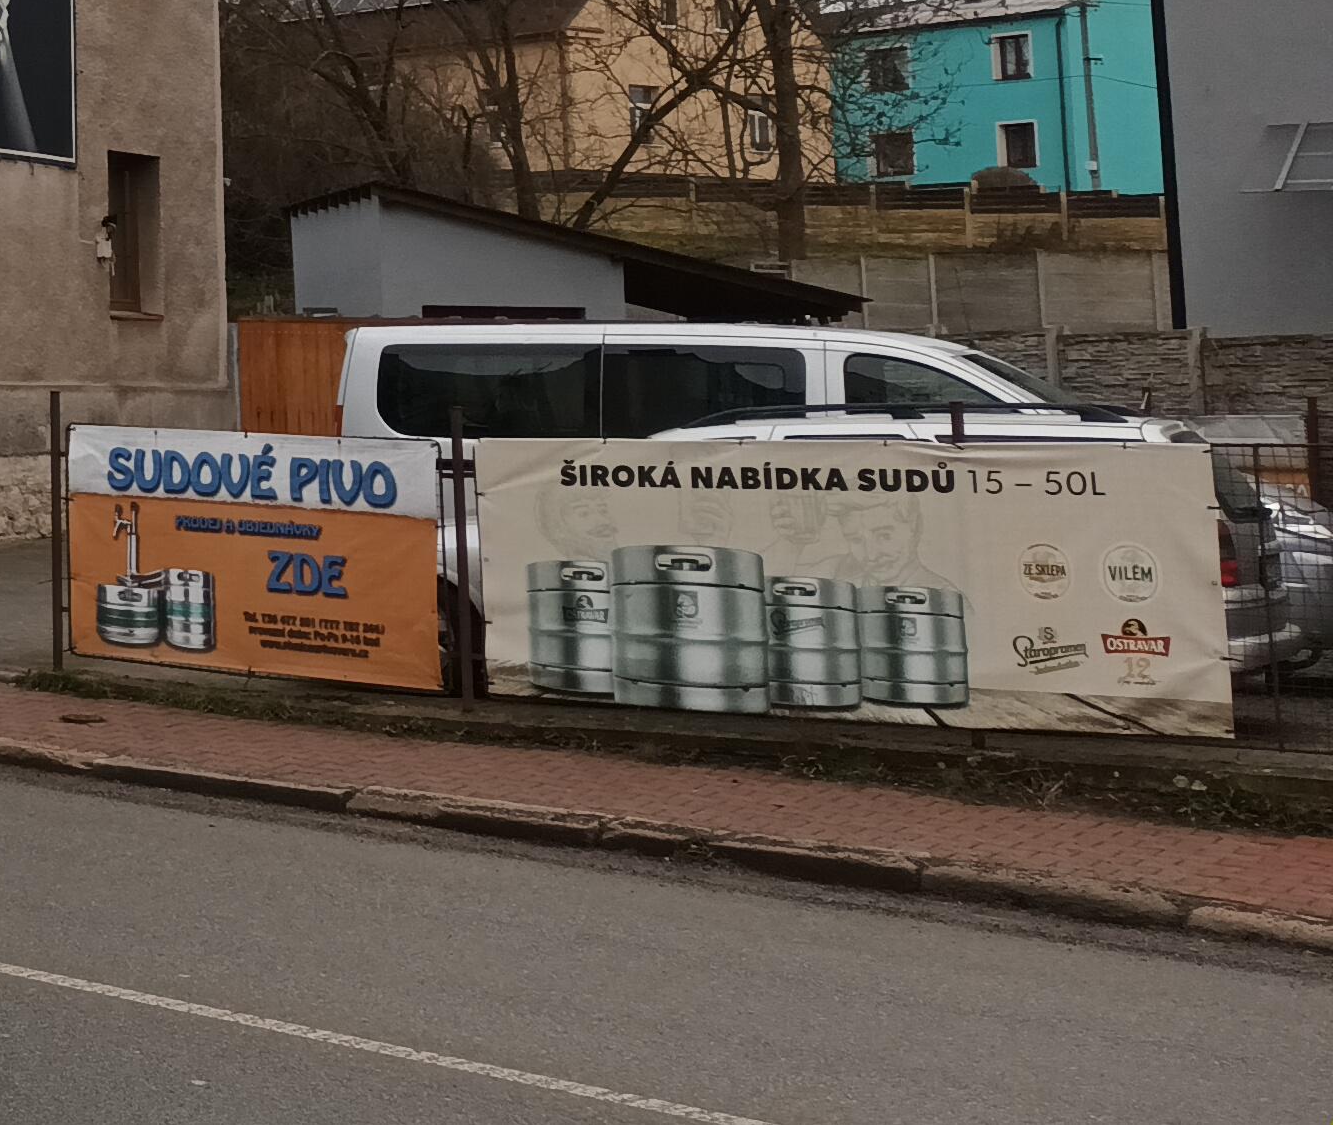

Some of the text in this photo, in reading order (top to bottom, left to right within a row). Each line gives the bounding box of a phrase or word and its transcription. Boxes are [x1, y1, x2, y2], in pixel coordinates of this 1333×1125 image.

[107, 443, 398, 509] SUDOVÉ PIVO
[560, 459, 681, 488] ŠIROKÁ
[690, 462, 849, 492] NABÍDKA
[857, 461, 955, 494] SUDŮ
[967, 470, 1003, 495] 15
[1044, 470, 1106, 496] 50L
[237, 518, 323, 540] OBJEDNÁVKY
[267, 550, 349, 600] ZDE
[1035, 563, 1066, 577] SKLEPA
[1107, 564, 1153, 582] VILÉM
[1012, 635, 1089, 667] Staropramen
[1106, 637, 1166, 653] OSTRAVAR
[1123, 657, 1151, 679] 12
